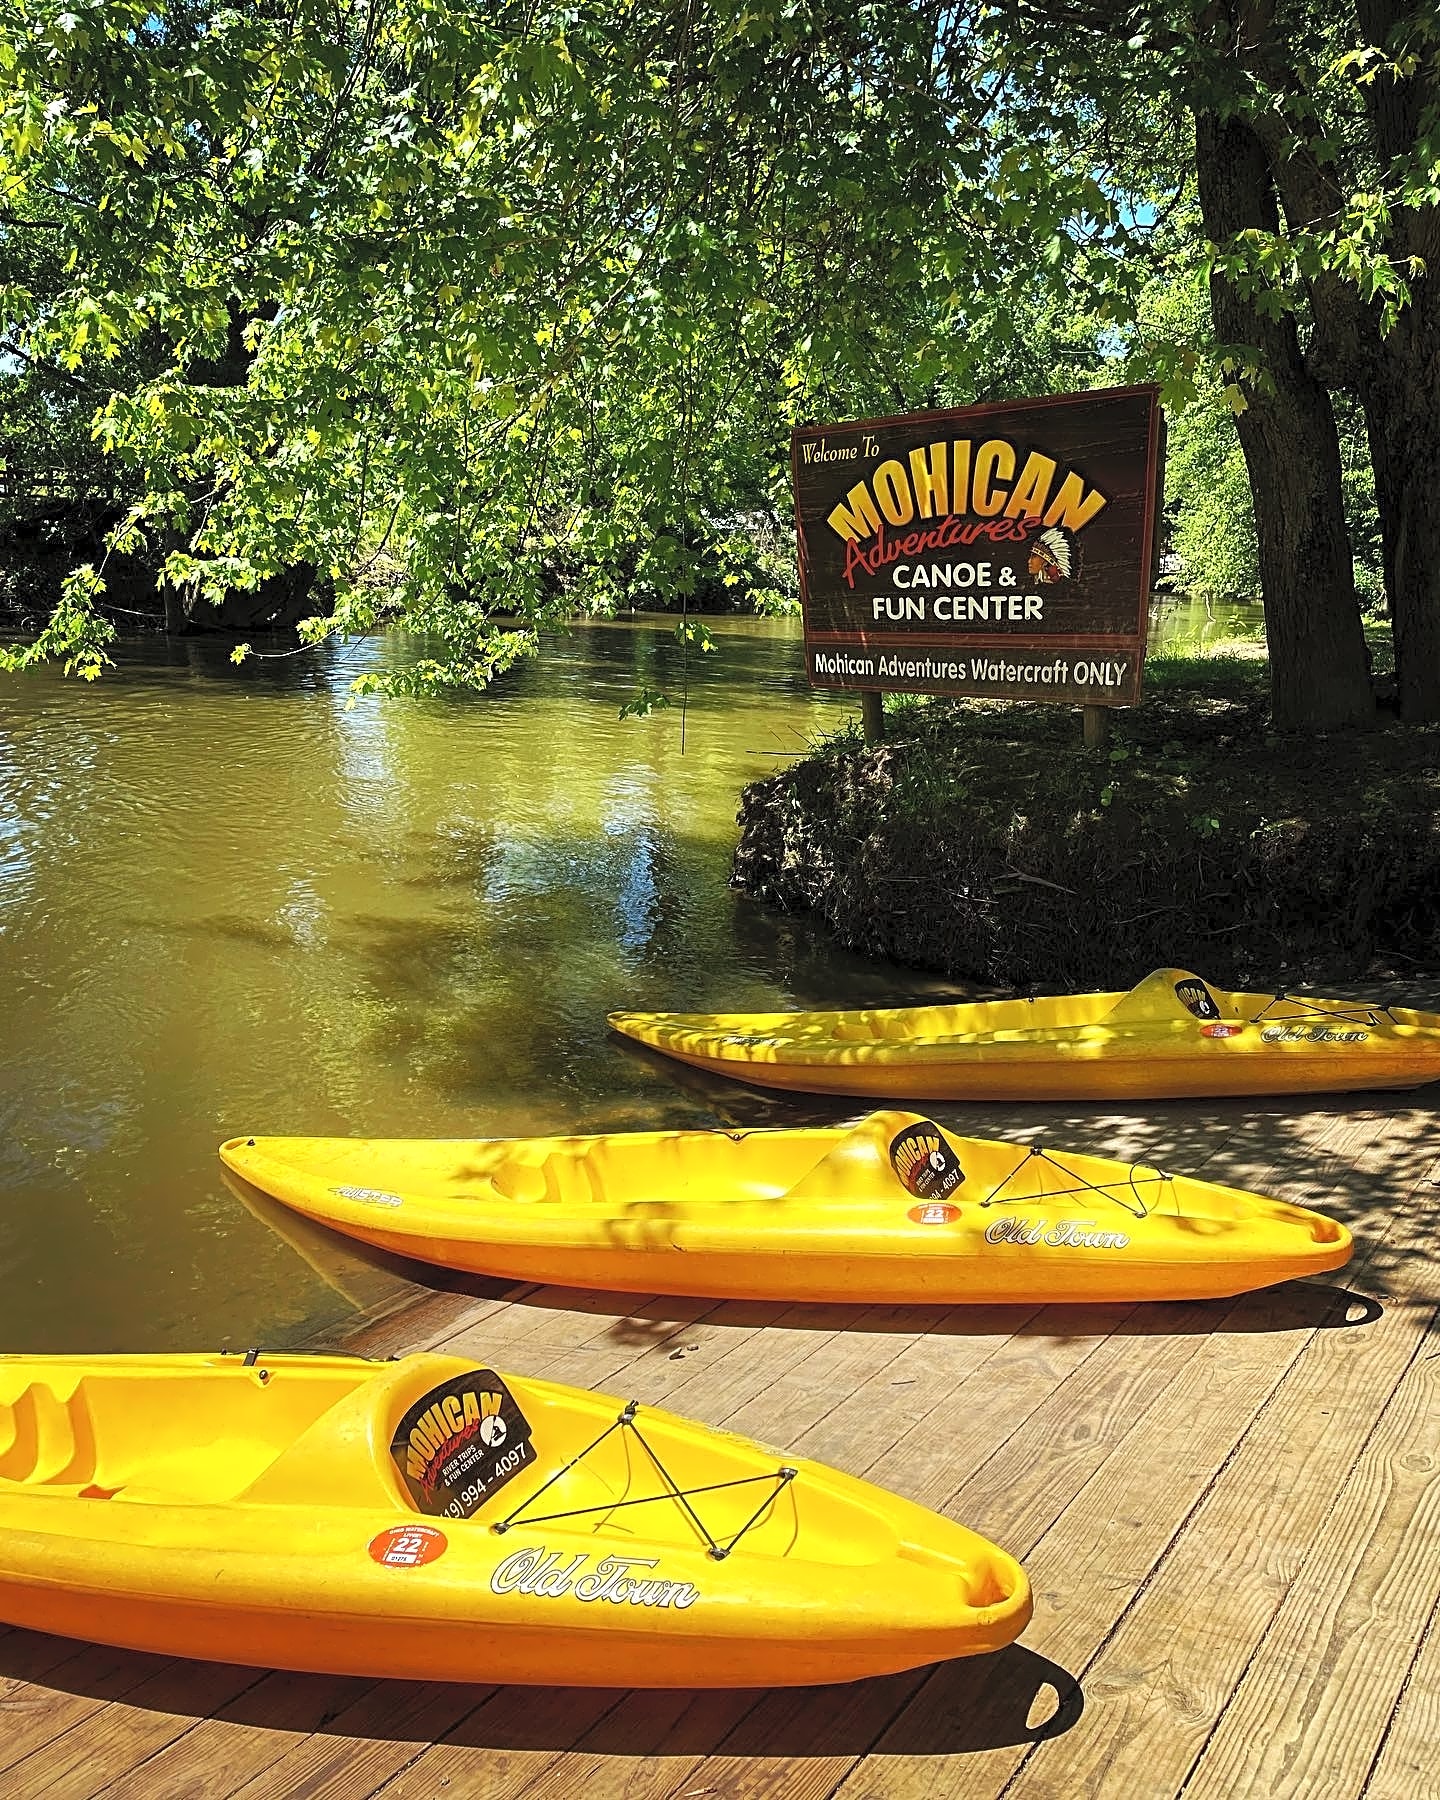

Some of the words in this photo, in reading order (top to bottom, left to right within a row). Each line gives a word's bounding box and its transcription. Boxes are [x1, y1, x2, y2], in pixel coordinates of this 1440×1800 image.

[802, 438, 858, 465] Welcome
[862, 435, 880, 458] To
[827, 439, 1107, 543] MOHICAN
[841, 515, 1042, 588] Adventures
[892, 562, 991, 588] CANOE
[998, 565, 1017, 587] &
[873, 597, 926, 620] FUN
[933, 595, 1044, 620] CENTER
[815, 653, 874, 676] Mohican
[878, 655, 966, 680] Adventures
[971, 658, 1068, 684] Watercraft
[1073, 661, 1127, 687] ONLY
[942, 1168, 960, 1190] 4097
[924, 1209, 944, 1218] 22
[984, 1216, 1043, 1245] Old
[1044, 1219, 1130, 1249] Town
[406, 1391, 503, 1481] MOHICAN
[442, 1459, 460, 1477] RIVER
[458, 1444, 477, 1462] TRIPS
[449, 1470, 462, 1483] FUN
[461, 1449, 485, 1472] CENTER
[440, 1498, 465, 1518] 19)
[461, 1477, 487, 1508] 994
[494, 1442, 527, 1478] 4097
[393, 1537, 422, 1553] 22
[490, 1546, 590, 1598] Old
[575, 1553, 701, 1610] Town
